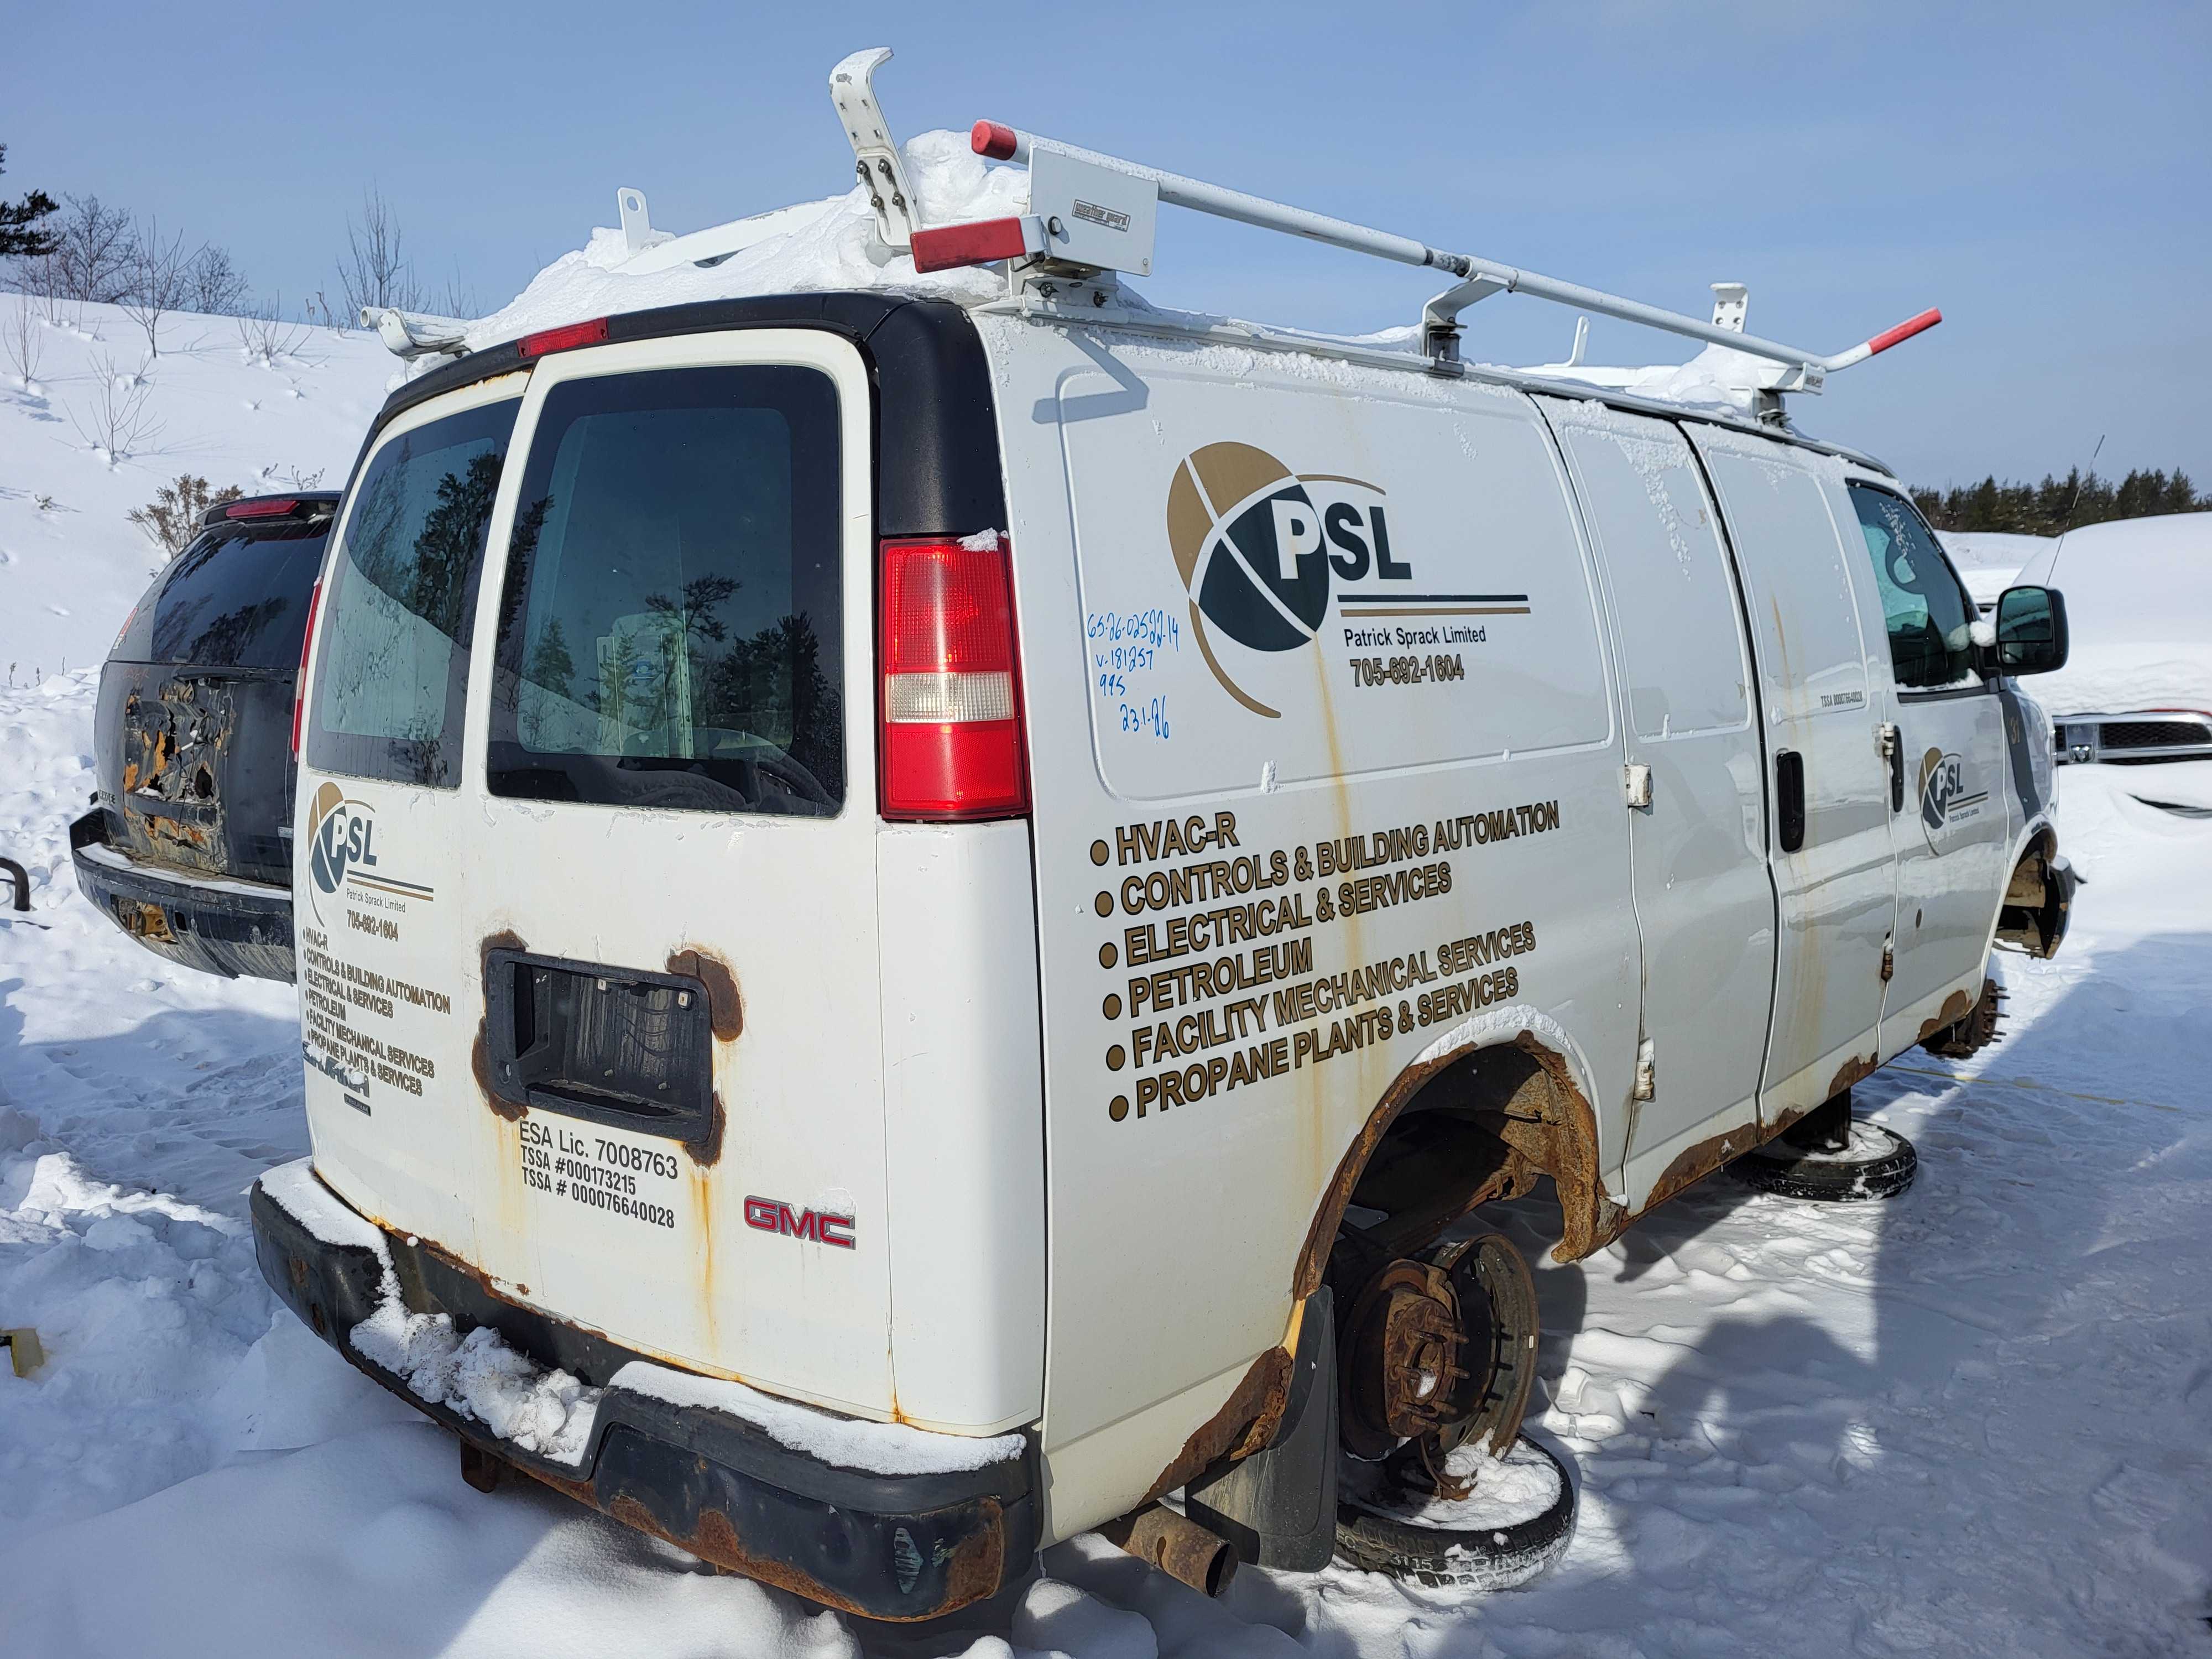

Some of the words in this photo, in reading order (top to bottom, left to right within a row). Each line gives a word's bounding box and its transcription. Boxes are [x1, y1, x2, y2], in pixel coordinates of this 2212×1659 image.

[1271, 499, 1412, 580] PSL
[1344, 628, 1392, 648] Patrick
[1397, 627, 1441, 651] Sprack
[1443, 625, 1486, 645] Limited
[1350, 654, 1465, 687] 705-692-1604
[1820, 695, 1833, 707] TSSA
[1937, 763, 1963, 801] PSL
[331, 813, 377, 866] PSL
[1115, 811, 1240, 866] HVAC-R
[1121, 849, 1289, 915] CONTROLS
[1295, 847, 1314, 880] &
[1318, 825, 1429, 877] BUILDING
[1433, 800, 1559, 853] AUTOMATION
[346, 889, 363, 903] Patrick
[365, 893, 383, 907] Sprack
[385, 898, 406, 912] Limited
[347, 910, 398, 941] 705-692-1604
[1125, 894, 1312, 967] ELECTRICAL
[1316, 888, 1335, 922] &
[1338, 862, 1453, 917] SERVICES
[306, 926, 328, 951] HVAC-R
[306, 950, 340, 979] CONTROLS
[341, 961, 346, 979] &
[347, 964, 384, 993] BUILDING
[386, 978, 451, 1015] AUTOMATION
[307, 969, 346, 1001] ELECTRICAL
[346, 987, 352, 1004] &
[353, 988, 394, 1018] SERVICES
[309, 989, 346, 1021] PETROLEUM
[1128, 937, 1313, 1018] PETROLEUM
[1133, 994, 1268, 1068] FACILITY
[1273, 951, 1437, 1027] MECHANICAL
[1439, 921, 1536, 971] SERVICES
[309, 1008, 336, 1034] FACILITY
[336, 1021, 386, 1061] MECHANICAL
[387, 1045, 435, 1078] SERVICES
[311, 1028, 340, 1060] PROPANE
[340, 1044, 369, 1073] PLANTS
[370, 1059, 377, 1077] &
[377, 1063, 423, 1097] SERVICES
[1136, 1038, 1290, 1118] PROPANE
[1295, 1006, 1395, 1069] PLANTS
[1397, 1000, 1415, 1032] &
[1418, 967, 1520, 1027] SERVICES
[519, 1120, 553, 1148] ESA
[559, 1129, 588, 1158] Lic.
[595, 1139, 678, 1179] 7008763
[520, 1145, 550, 1170] TSSA
[555, 1157, 636, 1196] #000173215
[522, 1166, 551, 1191] TSSA
[556, 1180, 567, 1196] #
[572, 1185, 675, 1229] 000076640028
[743, 1195, 856, 1250] GMC
